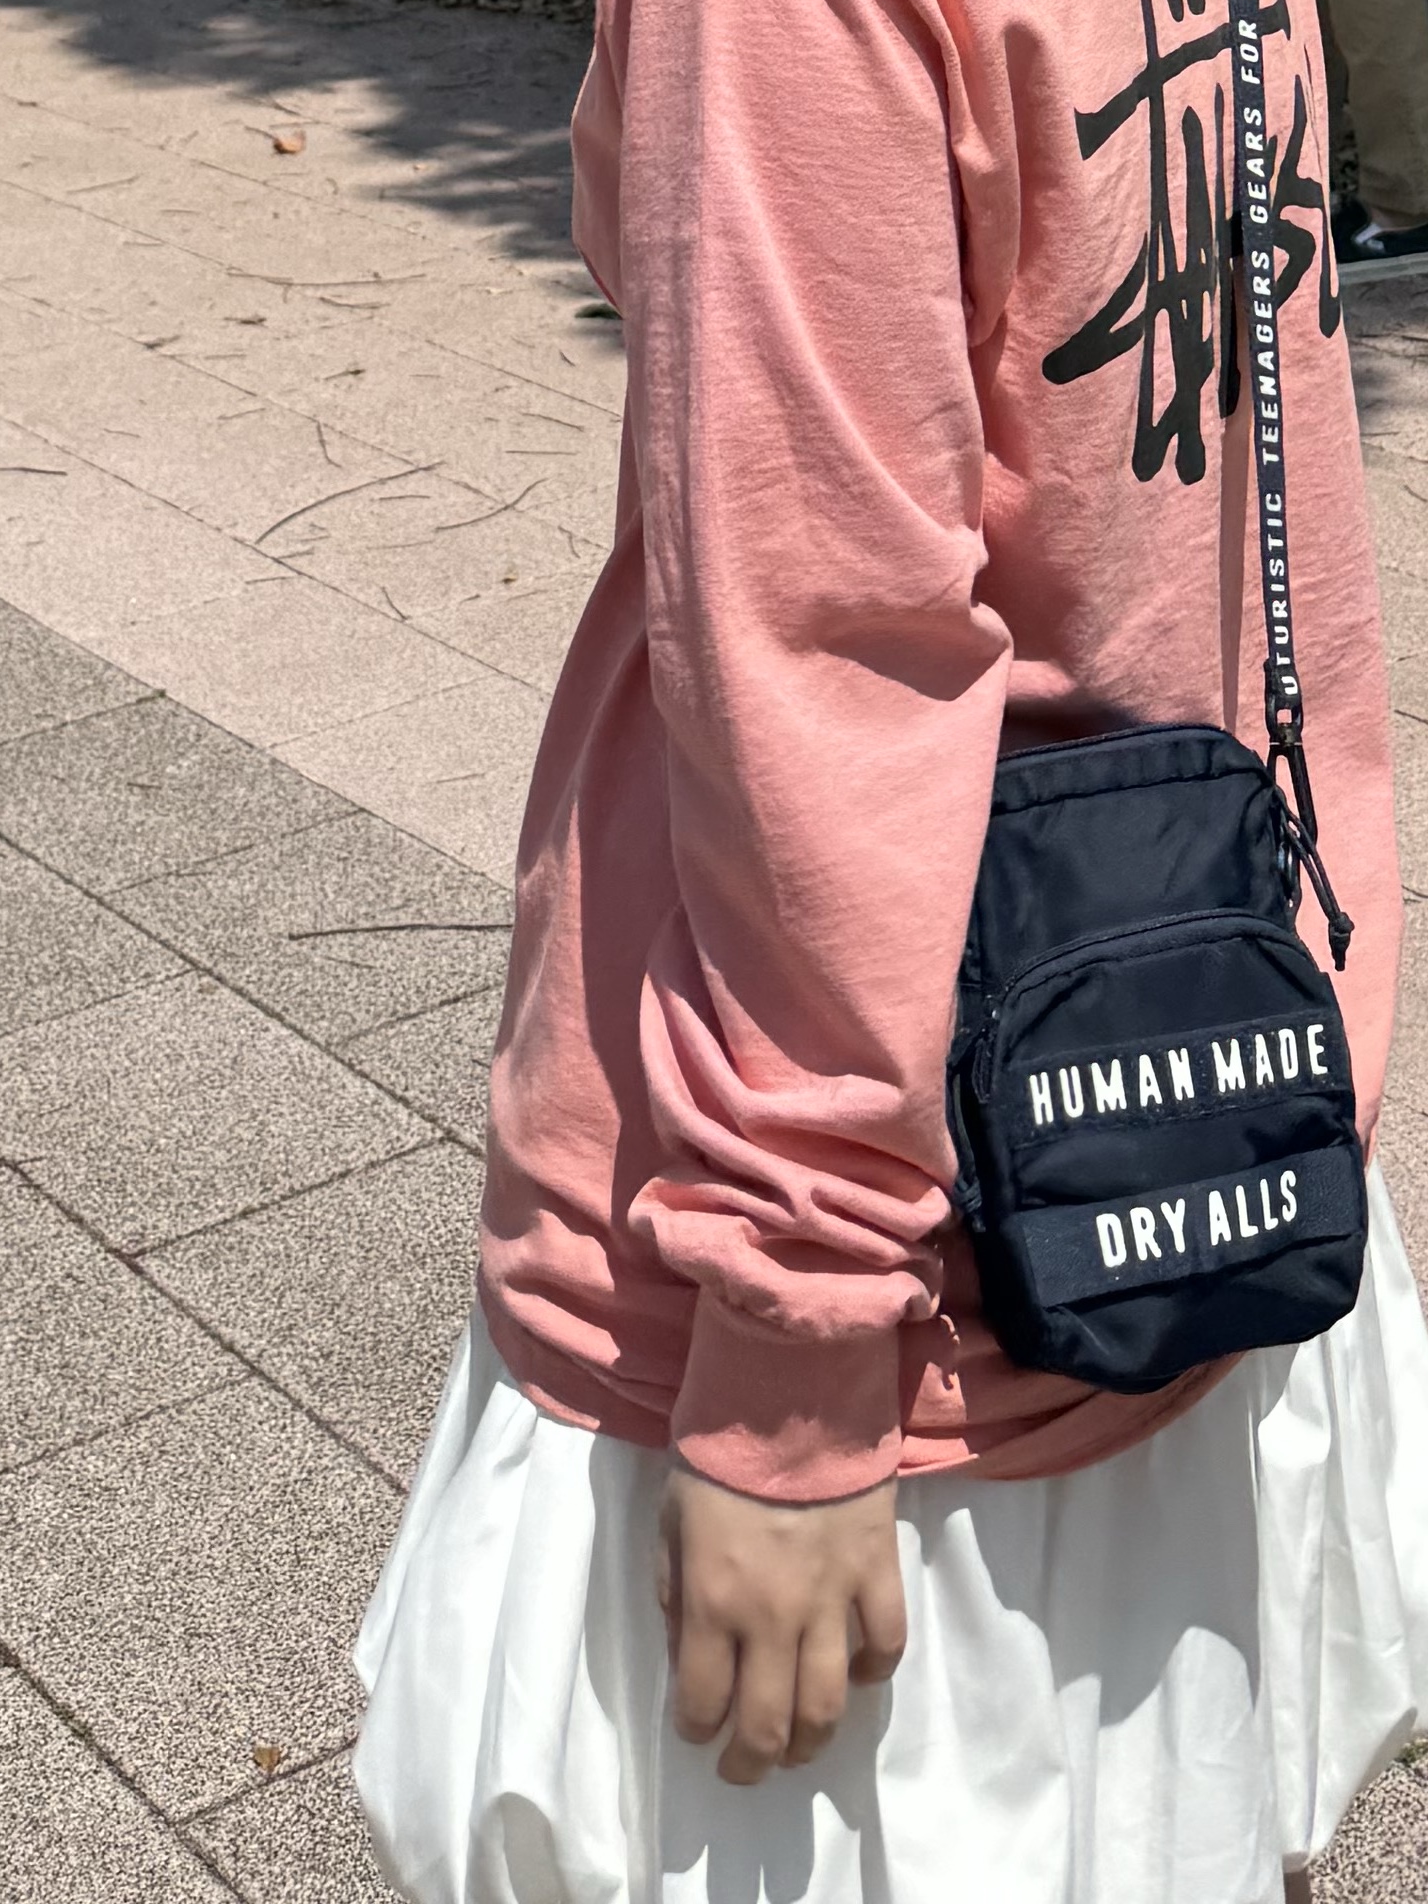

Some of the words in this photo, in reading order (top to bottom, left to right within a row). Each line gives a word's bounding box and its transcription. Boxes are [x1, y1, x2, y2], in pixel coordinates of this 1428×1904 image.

[1238, 19, 1262, 85] FOR
[1243, 106, 1270, 225] GEARS
[1251, 250, 1280, 466] TEENAGERS
[1265, 493, 1299, 695] UTURISTIC
[1028, 1046, 1196, 1126] HUMAN
[1210, 1023, 1329, 1095] MADE
[1095, 1197, 1186, 1269] DRY
[1208, 1168, 1299, 1247] ALLS
